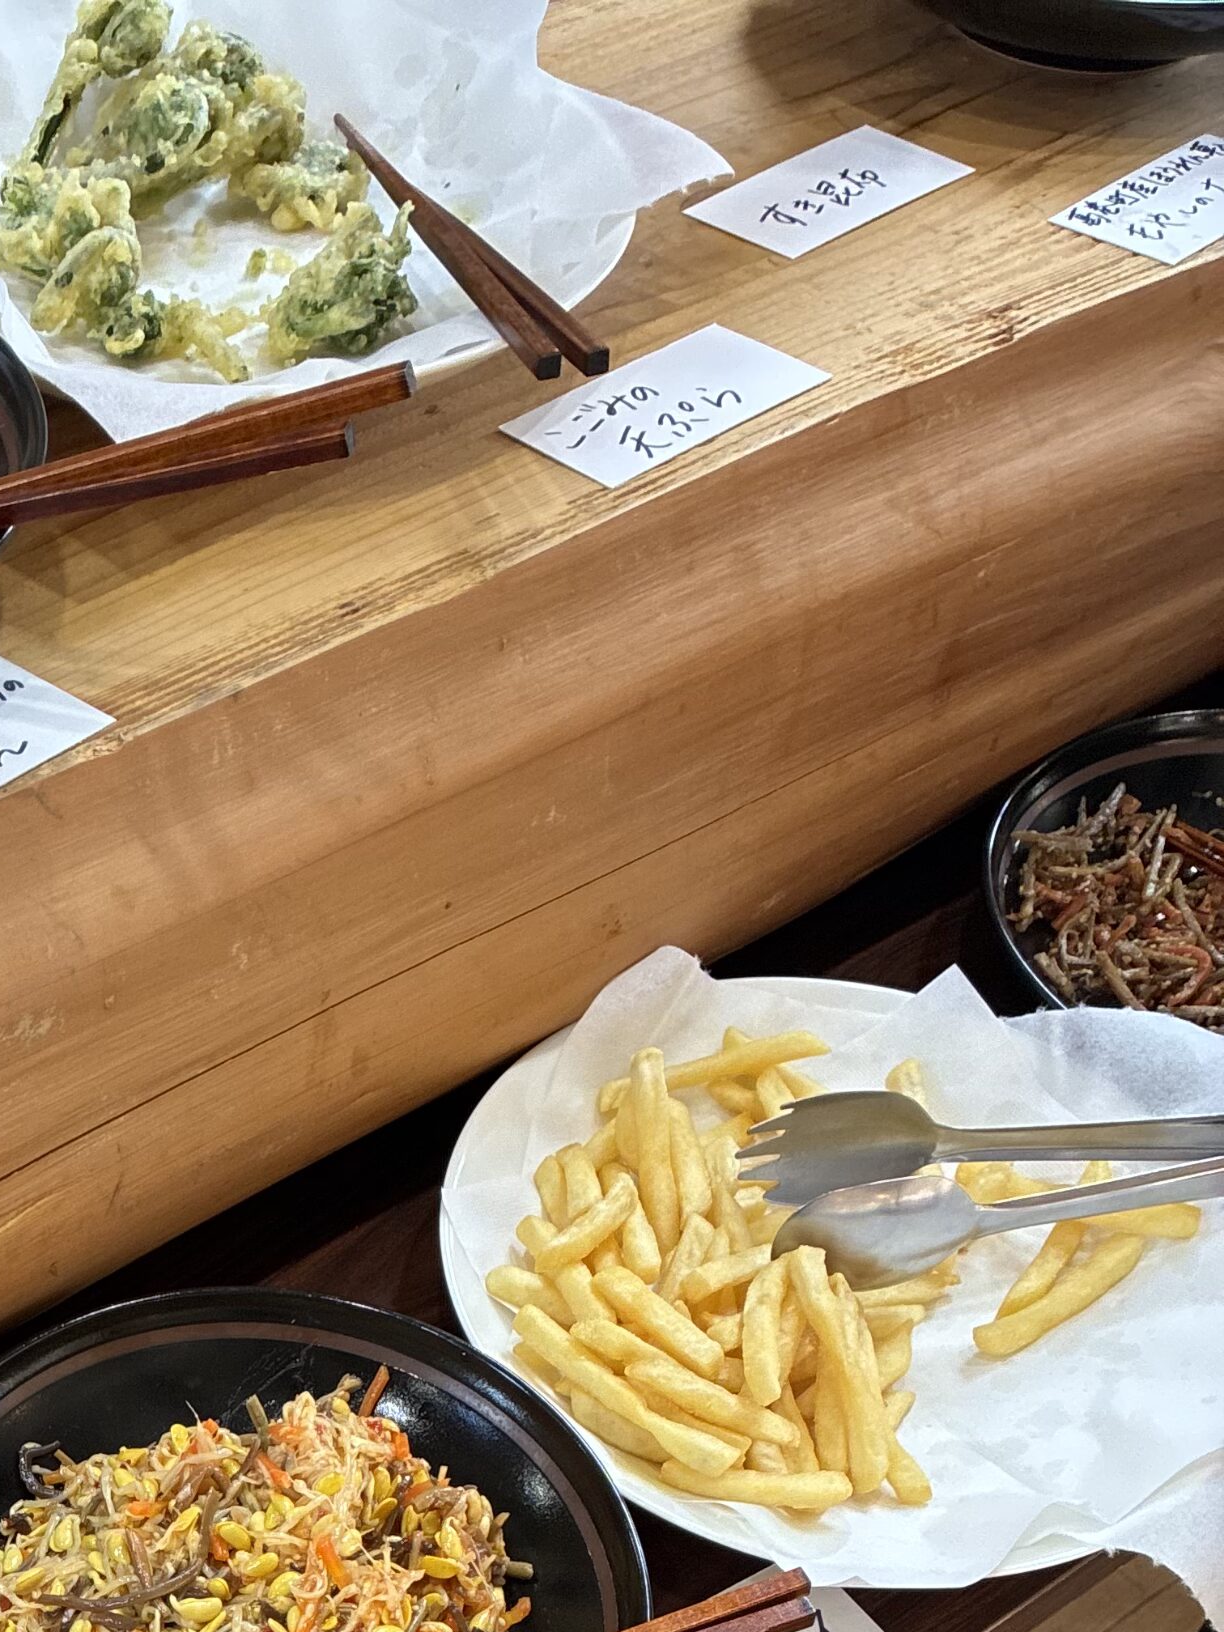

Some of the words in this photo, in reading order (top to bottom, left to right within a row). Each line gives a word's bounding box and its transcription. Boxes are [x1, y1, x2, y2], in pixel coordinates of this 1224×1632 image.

[759, 168, 881, 228] すき昆布
[544, 385, 660, 450] こごみの
[619, 387, 742, 459] 天ぷら
